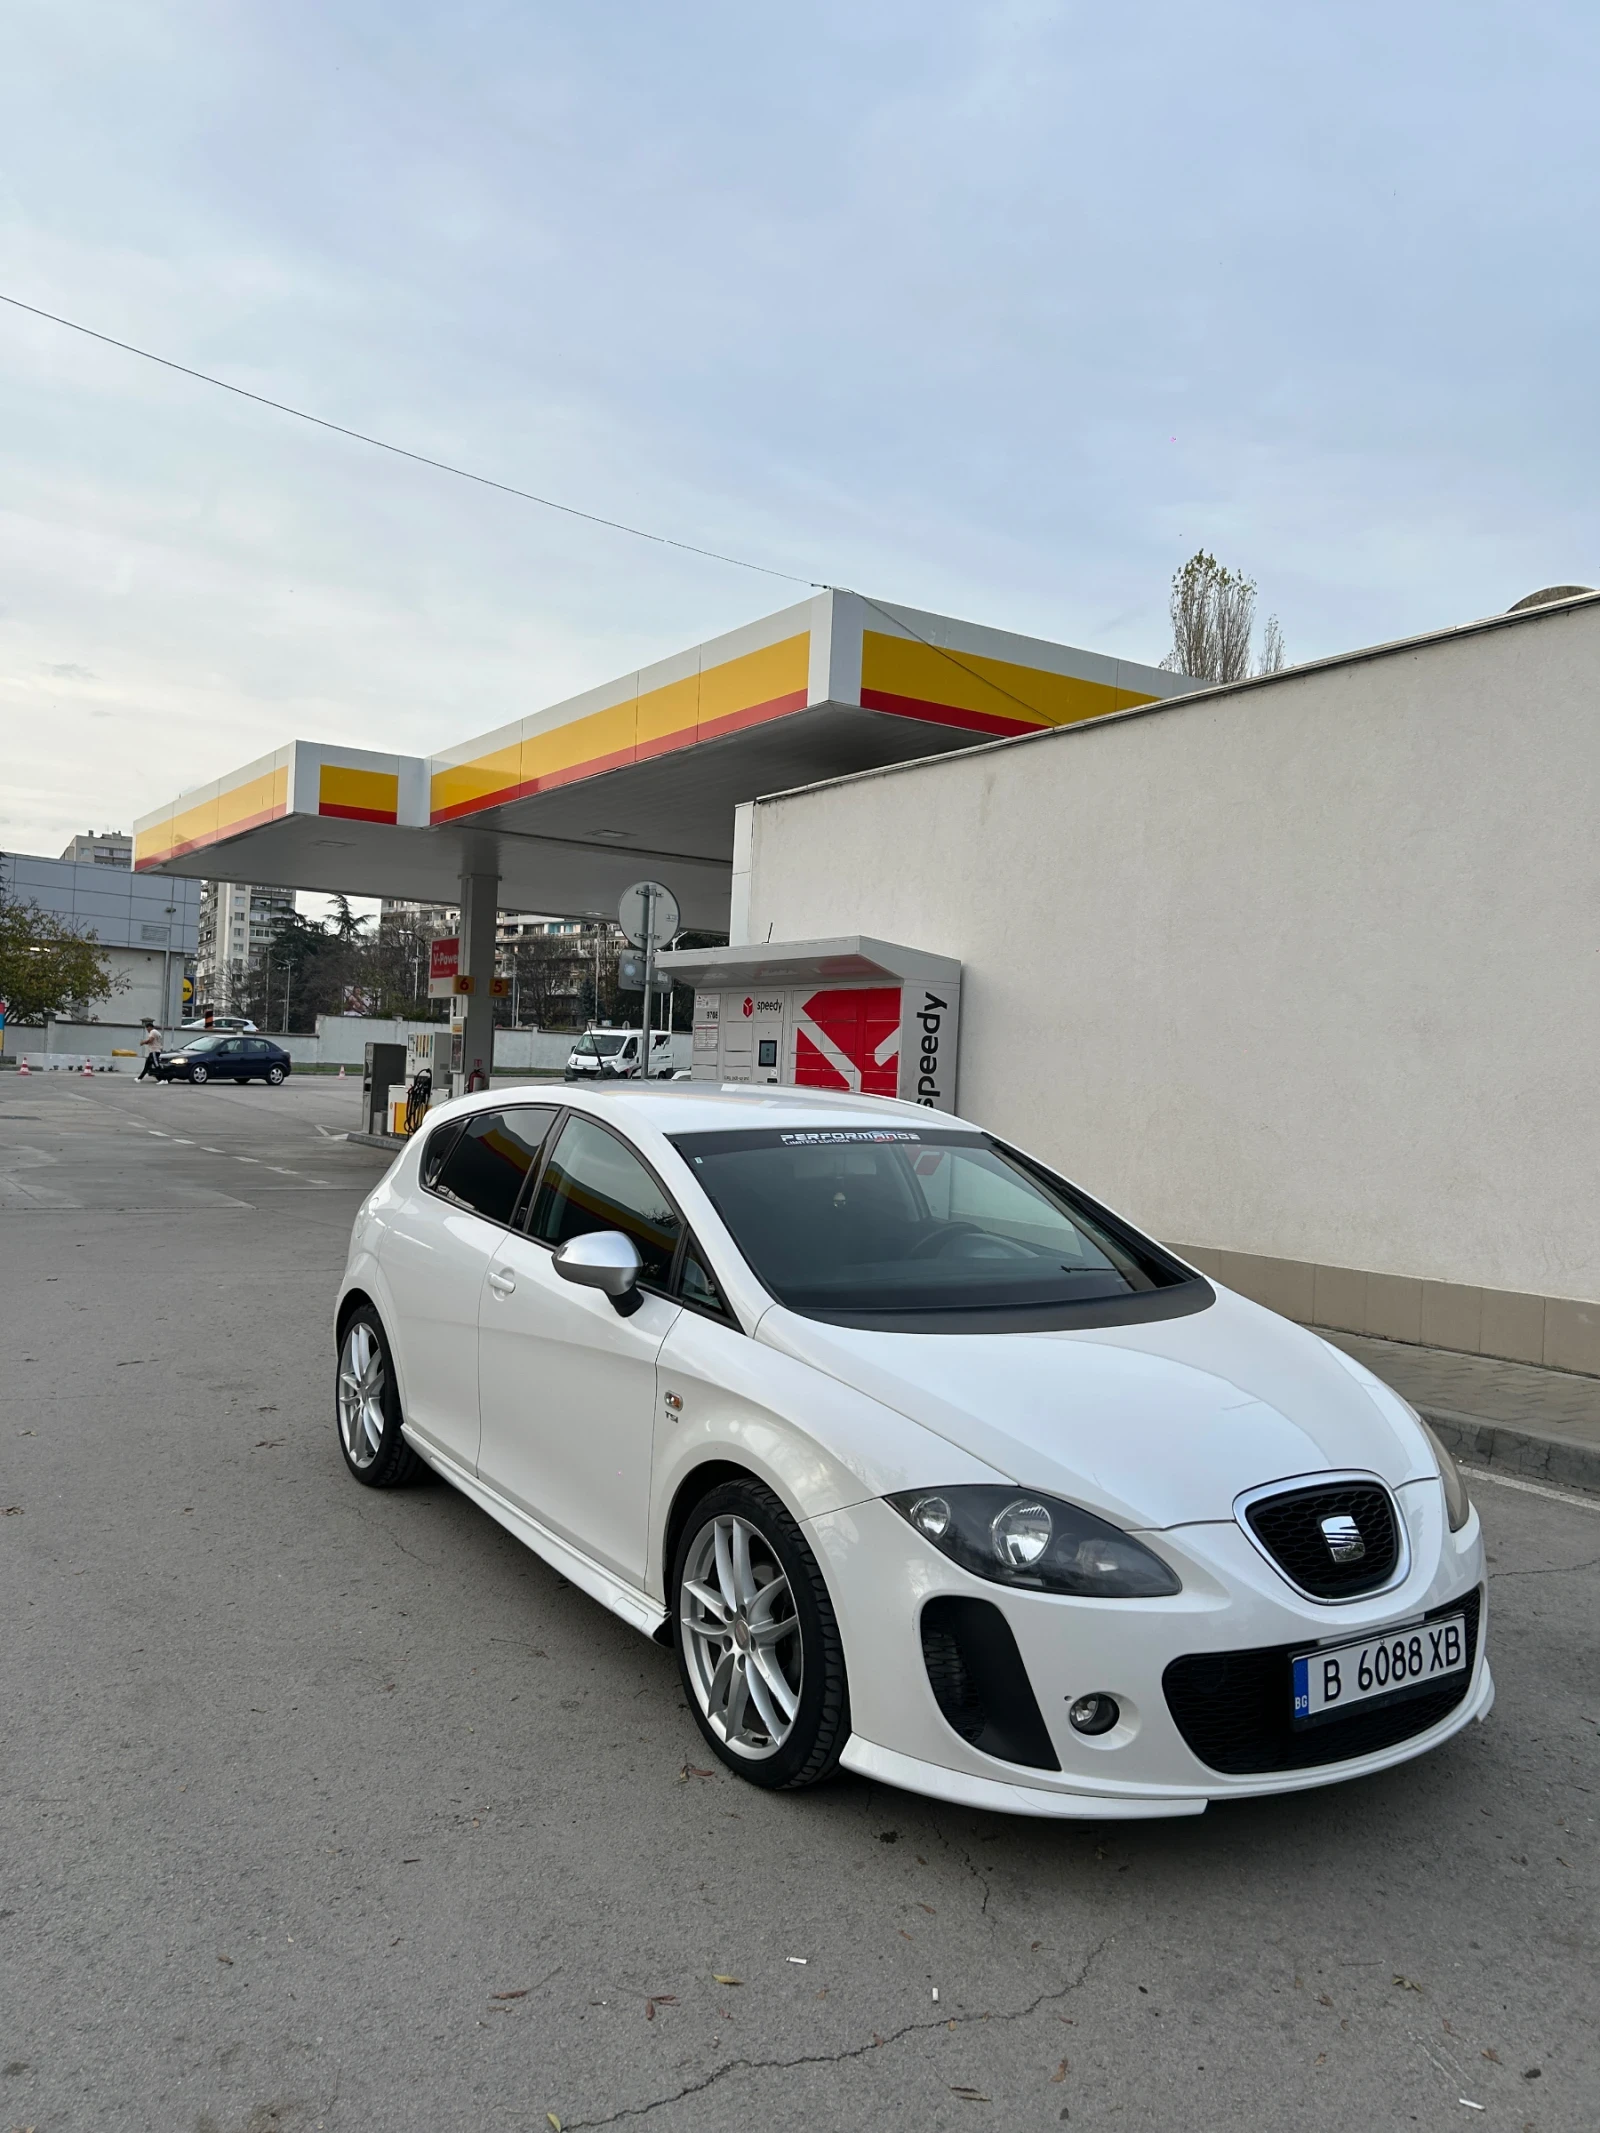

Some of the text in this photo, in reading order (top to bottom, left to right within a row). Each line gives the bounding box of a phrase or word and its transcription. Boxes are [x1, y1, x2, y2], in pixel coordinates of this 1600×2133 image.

[433, 951, 458, 966] V-Powe
[460, 978, 469, 991] 6
[493, 980, 503, 993] 5
[757, 999, 782, 1013] speedy
[780, 1132, 921, 1142] PERFORMANCE
[1323, 1625, 1461, 1703] B 6088 XB
[1294, 1694, 1308, 1710] BG
